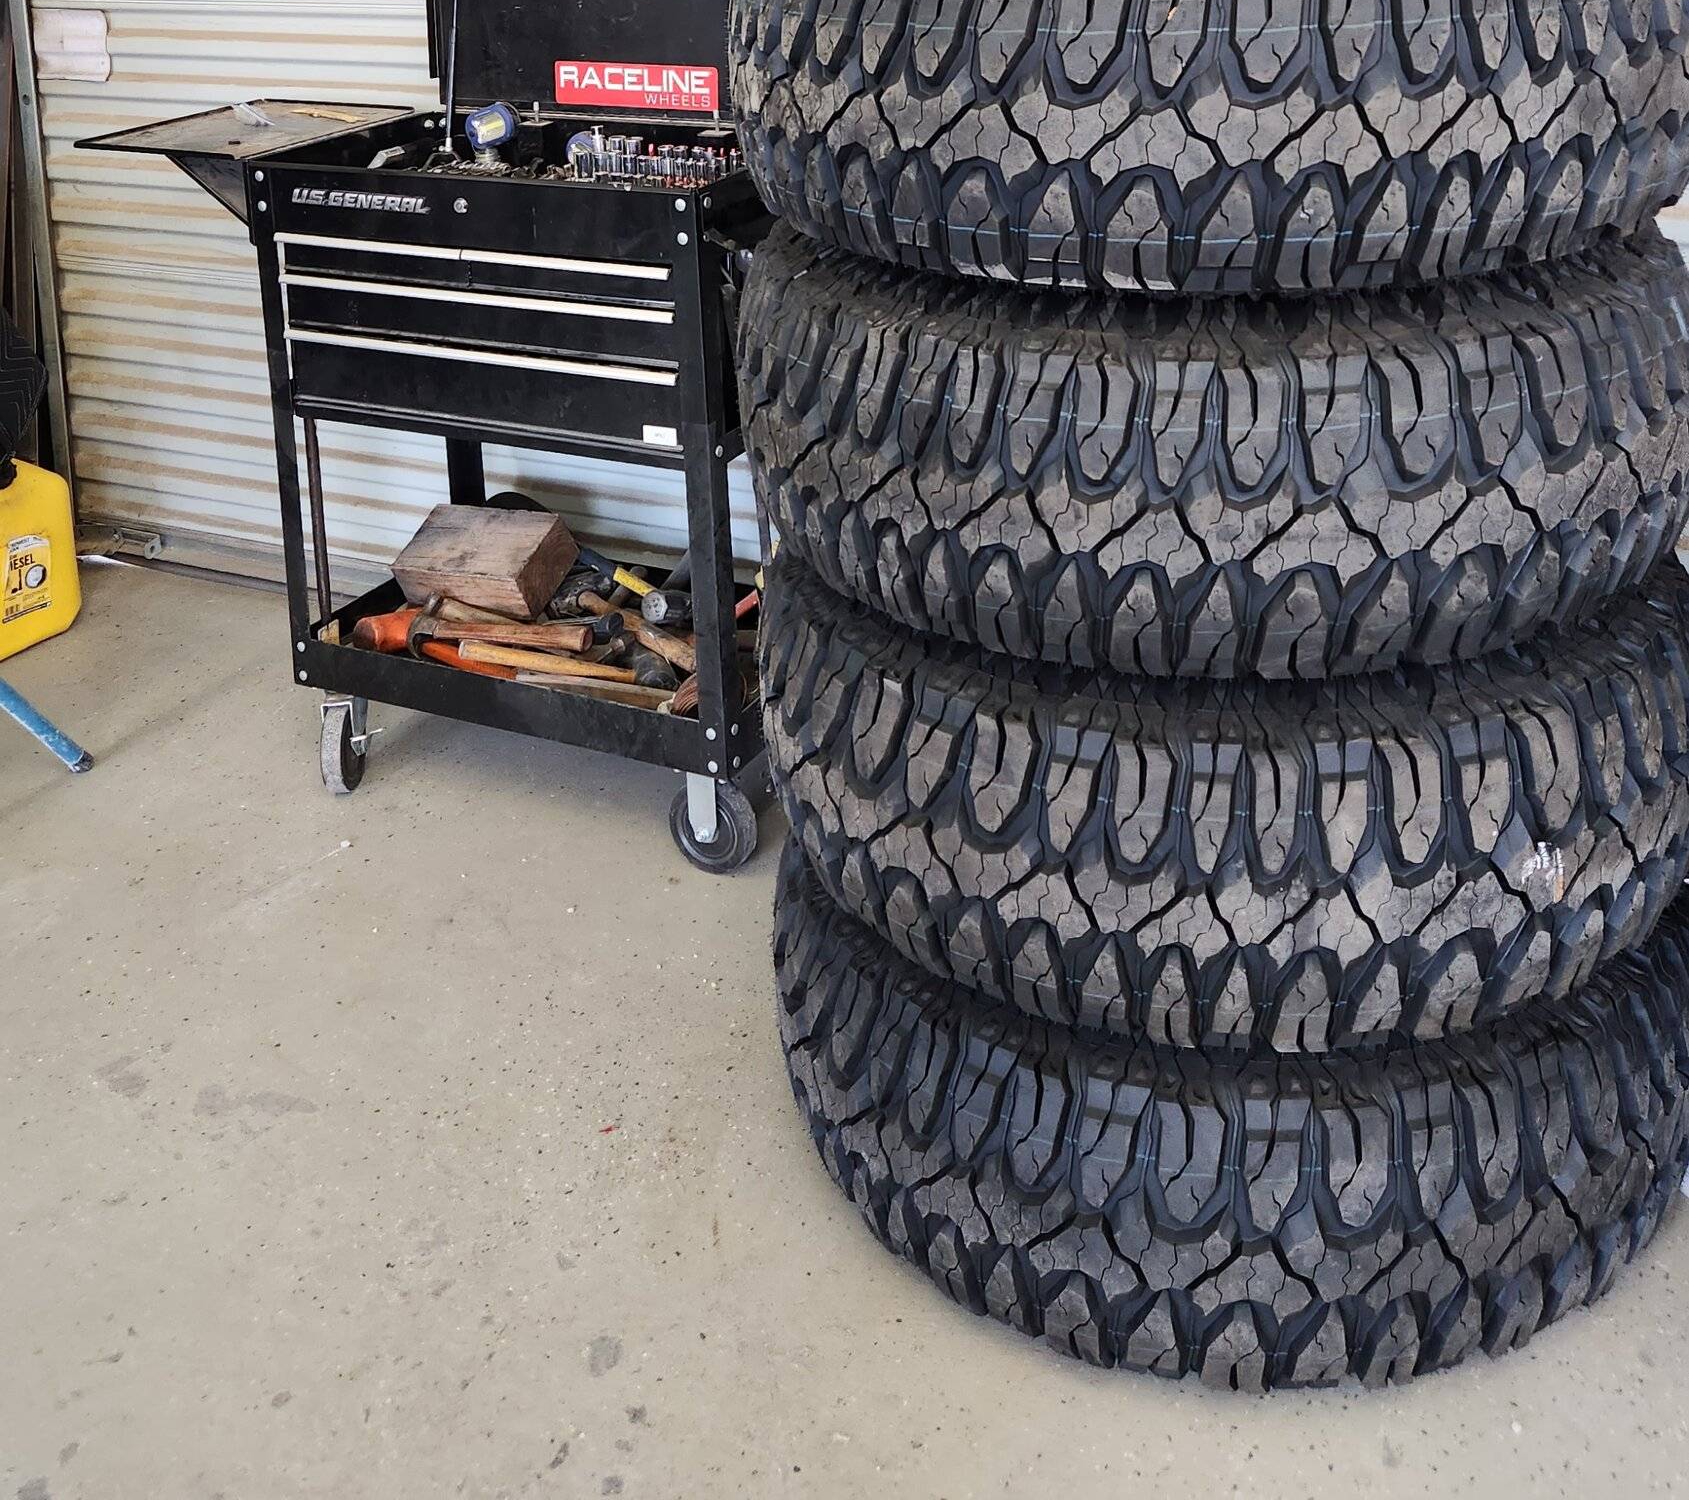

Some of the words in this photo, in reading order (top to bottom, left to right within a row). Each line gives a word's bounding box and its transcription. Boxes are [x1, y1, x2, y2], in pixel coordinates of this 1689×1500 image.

[559, 65, 711, 94] RACELINE
[644, 93, 711, 108] WHEELS
[327, 191, 432, 215] GENERAL
[10, 553, 36, 571] IESEL
